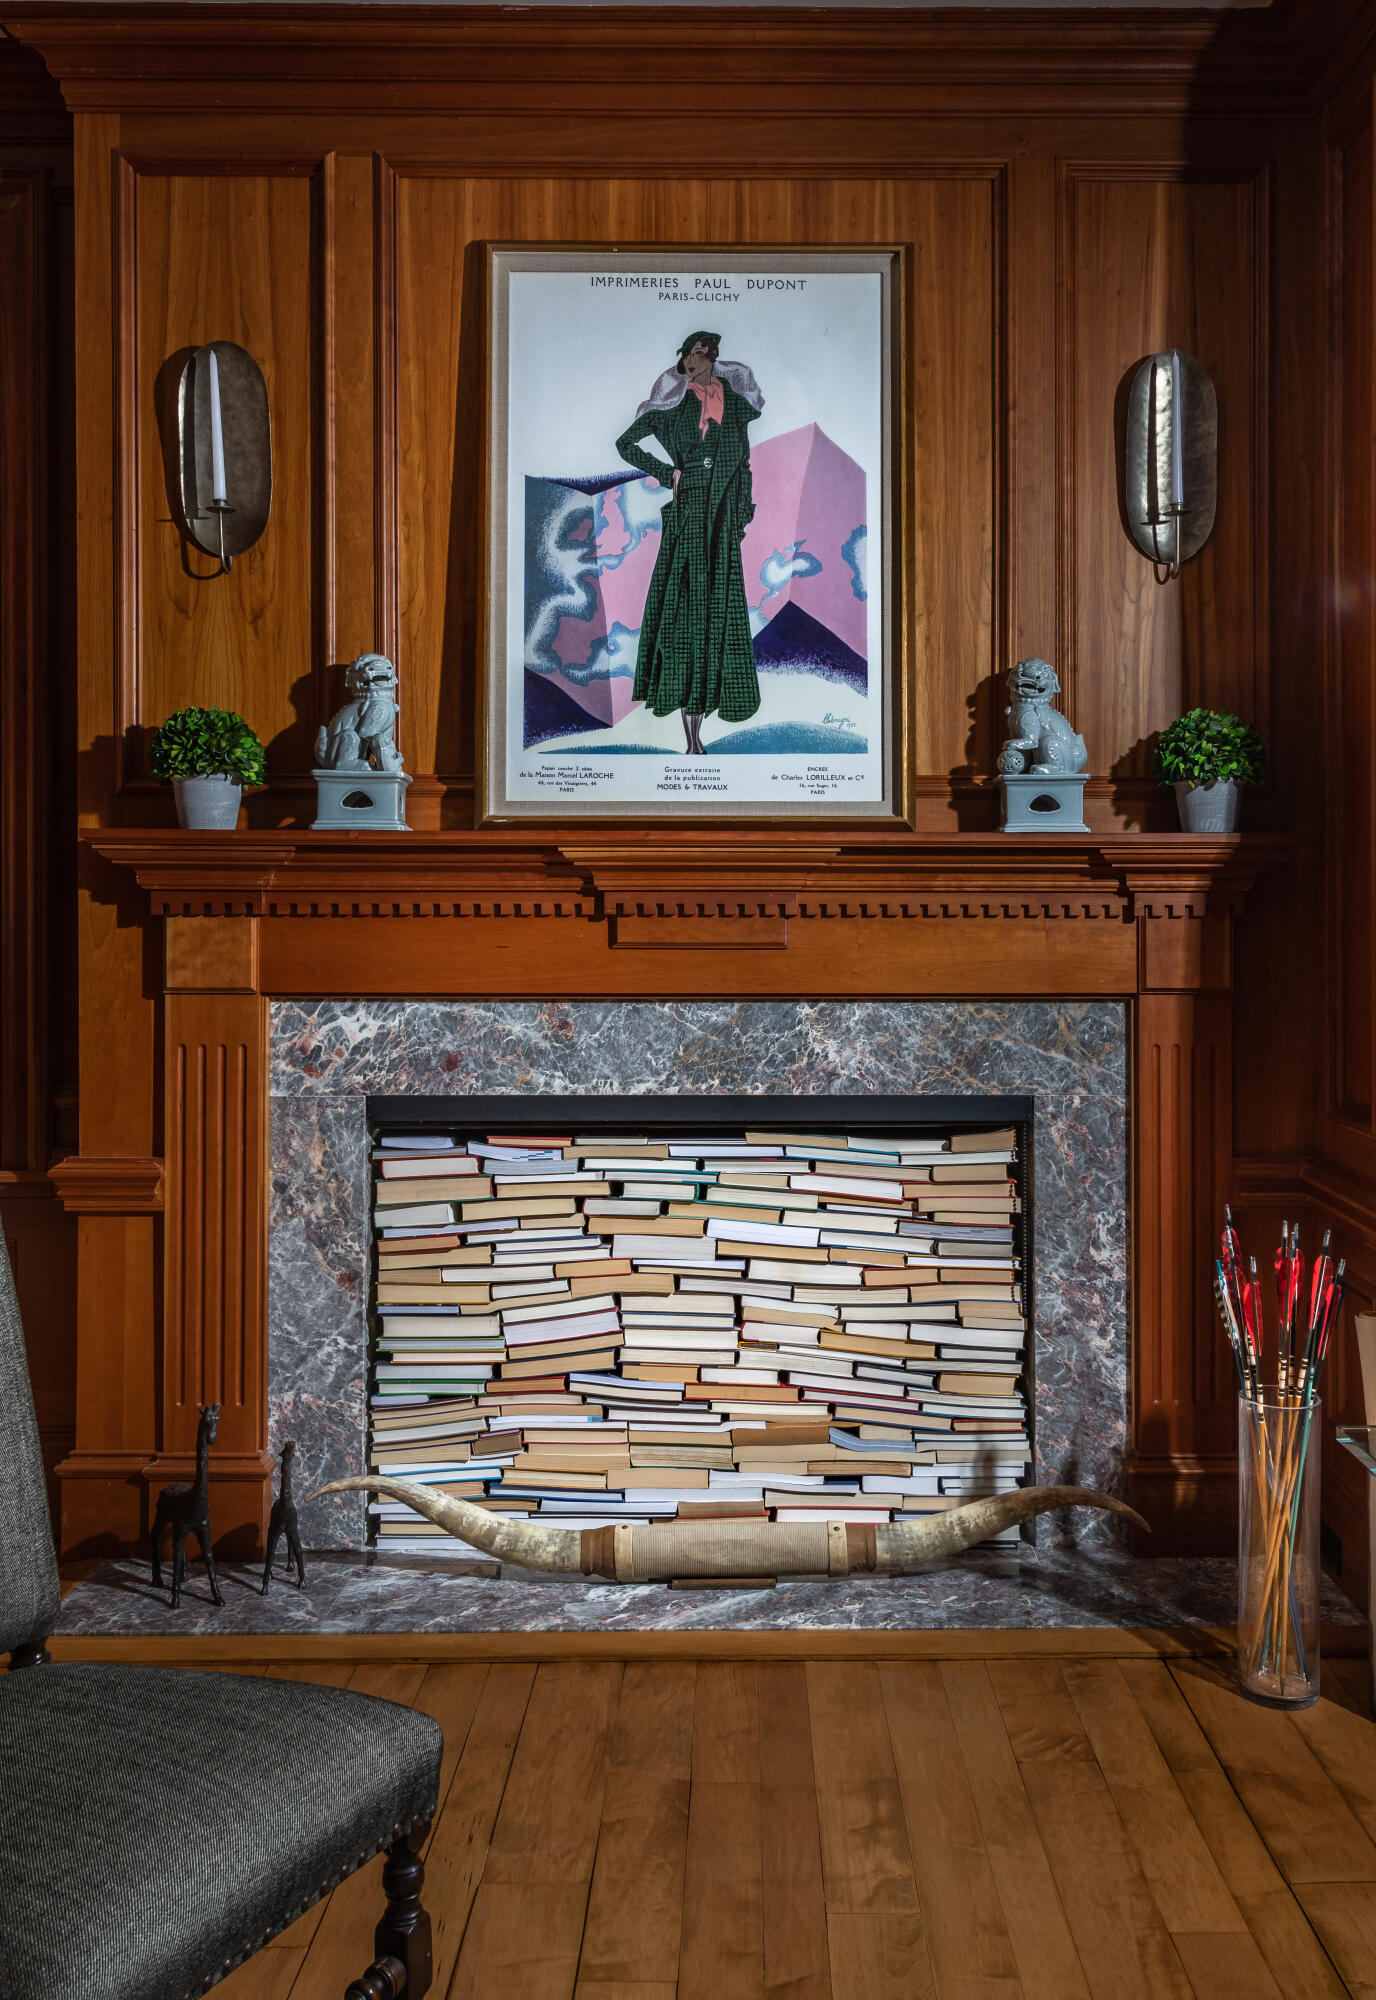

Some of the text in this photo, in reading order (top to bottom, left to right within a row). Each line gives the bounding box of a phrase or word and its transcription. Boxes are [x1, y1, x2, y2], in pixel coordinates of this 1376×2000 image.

[591, 276, 808, 290] IMPRIMERIES PAUL DUPONT
[658, 292, 740, 302] PARIS-CLICHY
[682, 774, 721, 782] publication
[656, 783, 682, 791] MODES
[692, 783, 728, 791] TRAVAUX
